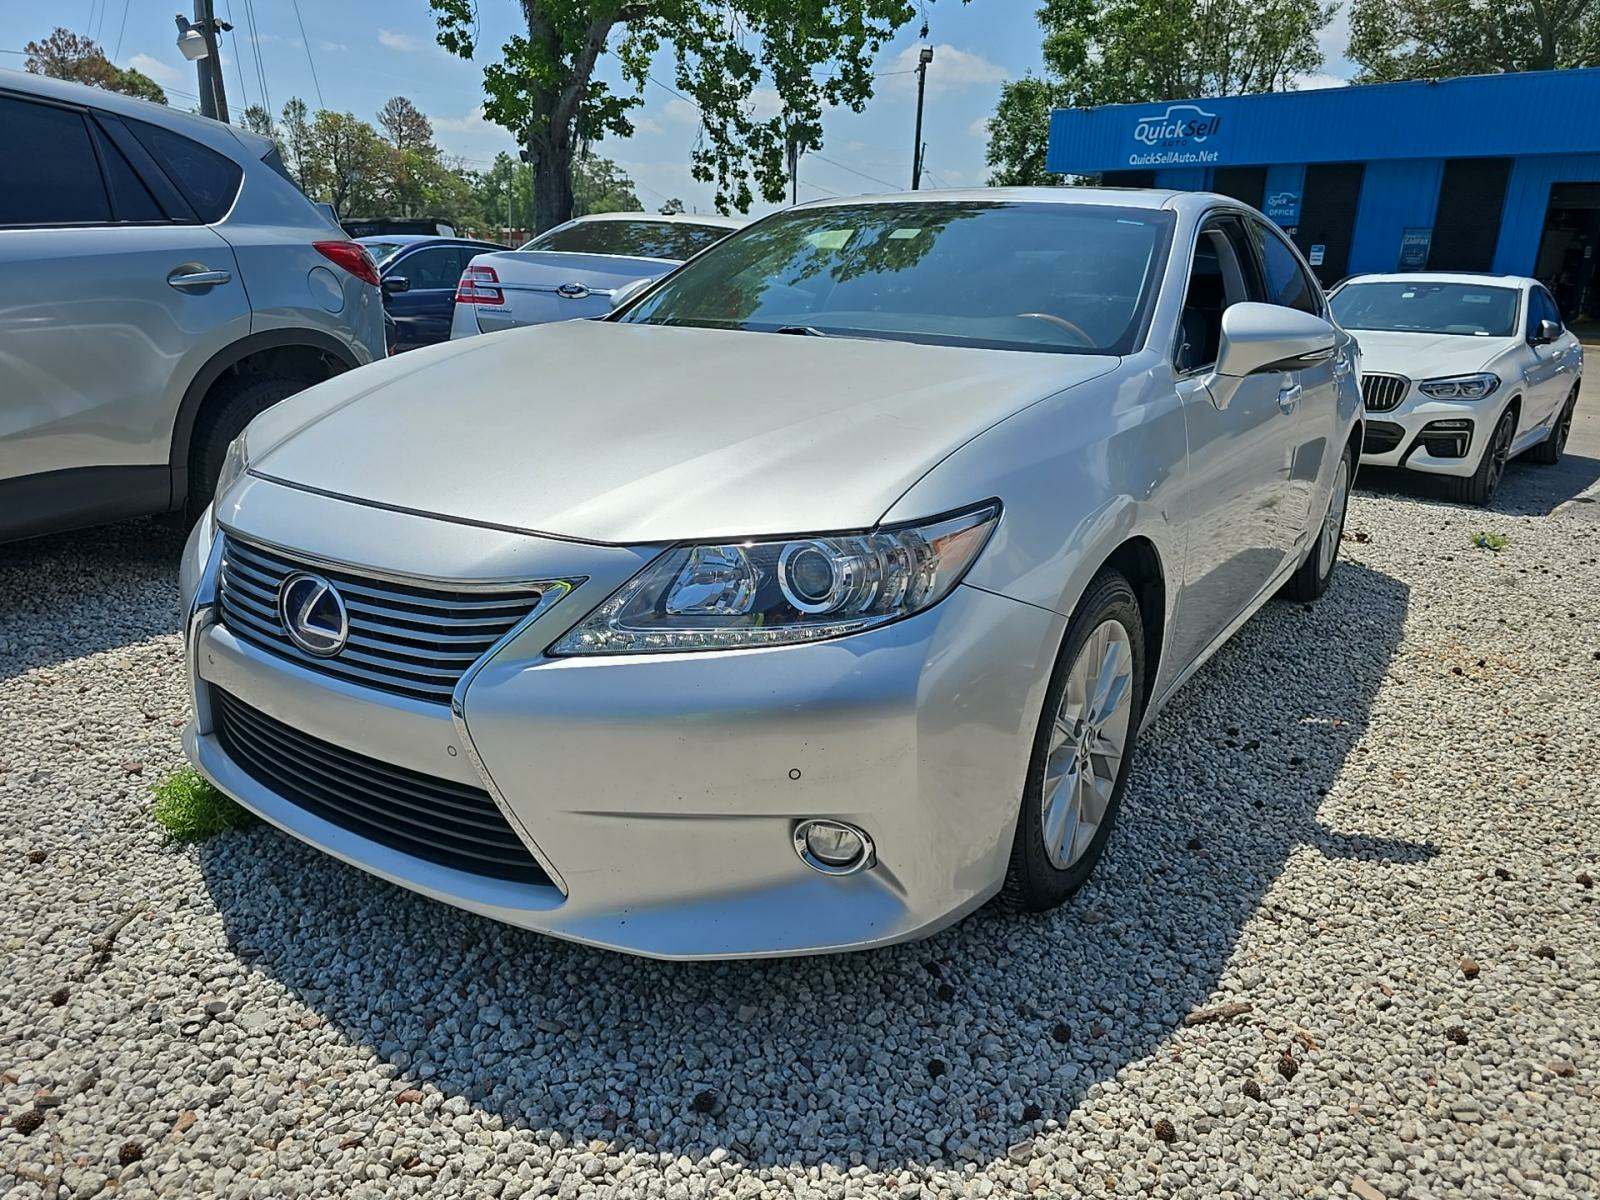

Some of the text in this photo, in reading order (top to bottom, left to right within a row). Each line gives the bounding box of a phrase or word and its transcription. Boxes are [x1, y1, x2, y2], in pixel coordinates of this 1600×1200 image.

[1134, 117, 1221, 145] QuickSell
[1129, 151, 1219, 165] QuickSellAuto.Net
[1269, 208, 1295, 216] OFFICE
